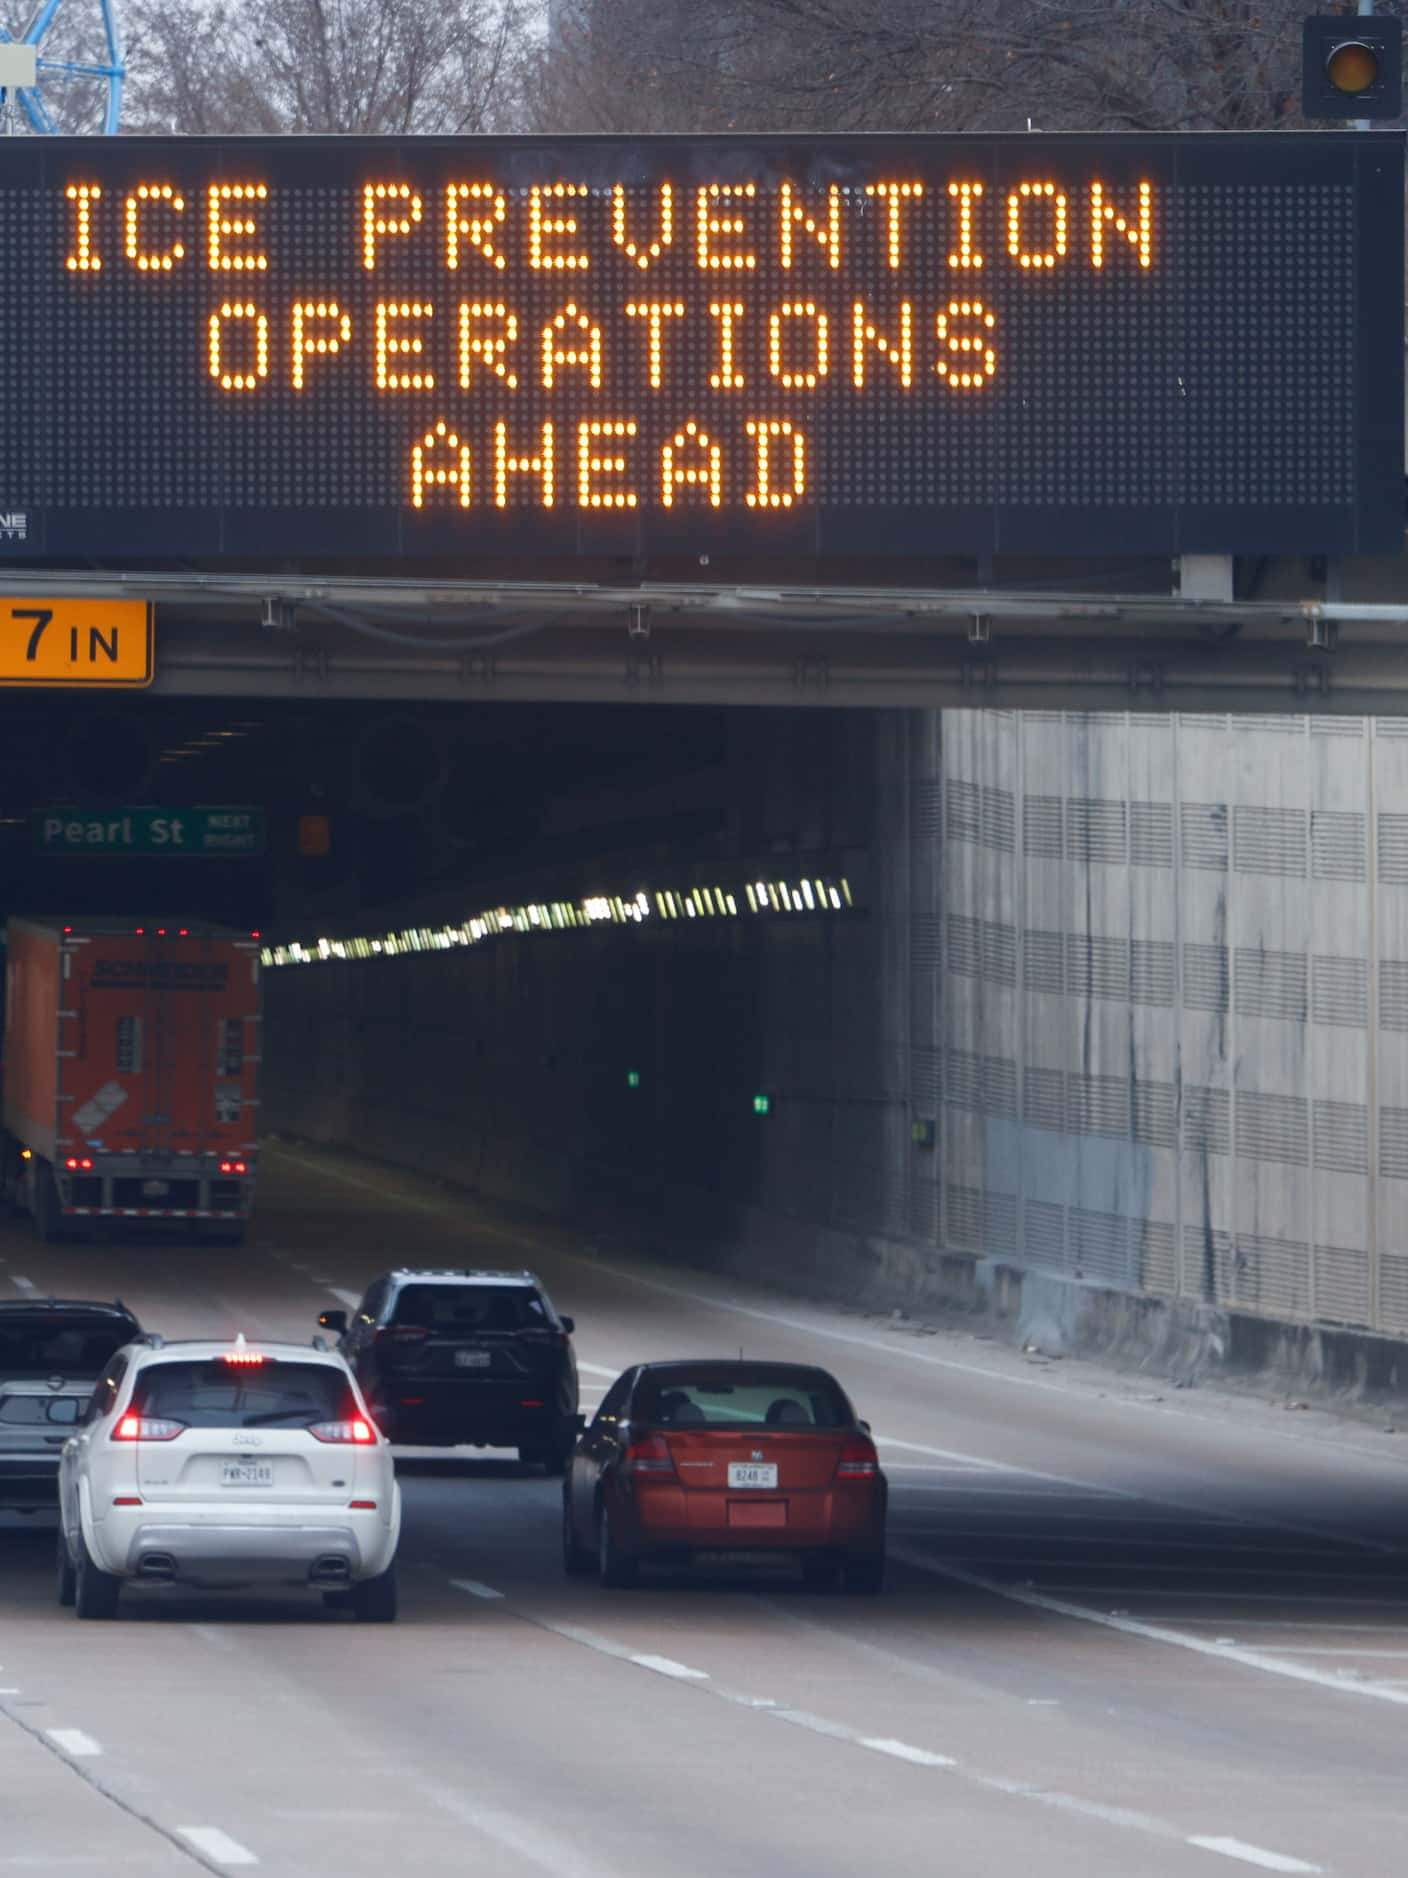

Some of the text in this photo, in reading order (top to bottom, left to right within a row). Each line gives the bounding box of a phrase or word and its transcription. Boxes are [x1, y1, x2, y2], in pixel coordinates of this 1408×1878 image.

[66, 183, 1151, 270] ICE PREVENTION
[208, 301, 997, 390] OPERATIONS
[411, 418, 805, 508] AHEAD
[44, 816, 186, 846] Pearl St
[207, 815, 251, 830] NEXT
